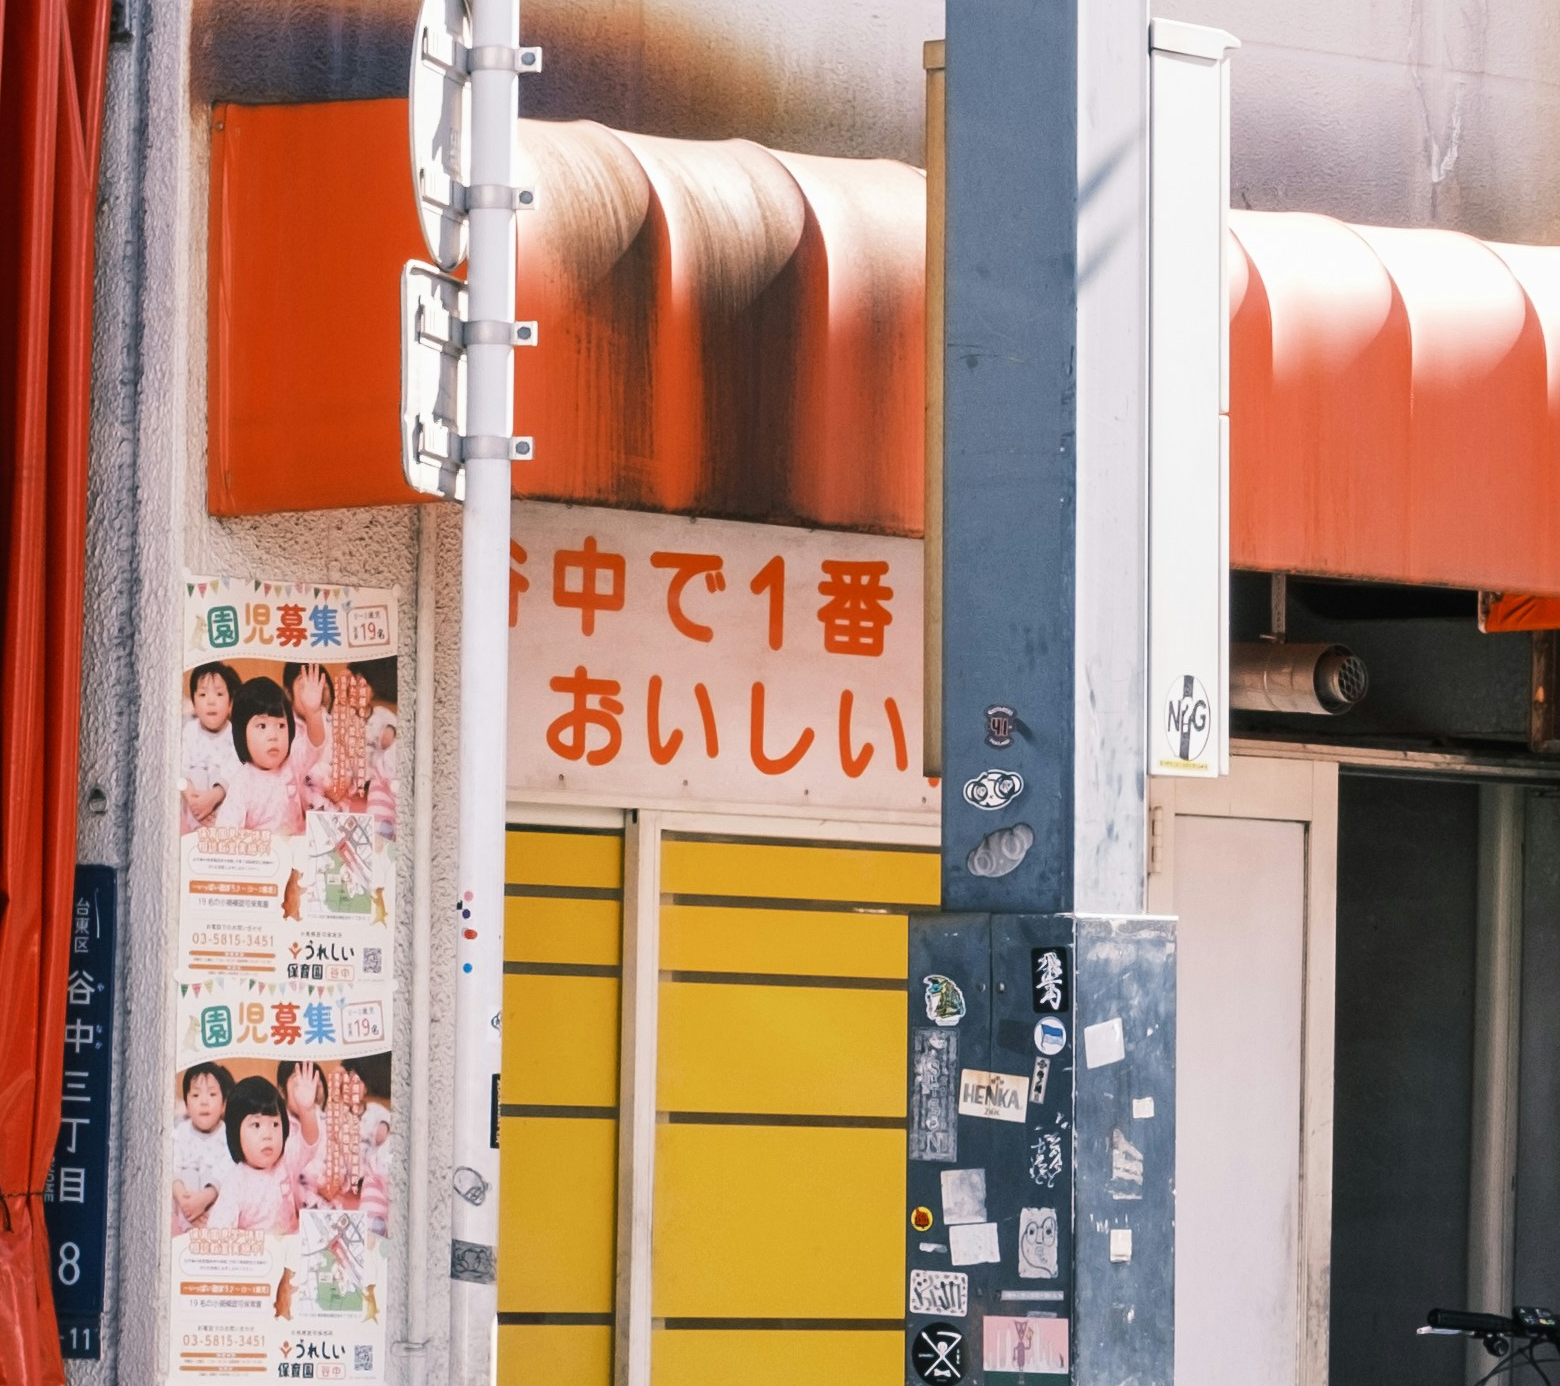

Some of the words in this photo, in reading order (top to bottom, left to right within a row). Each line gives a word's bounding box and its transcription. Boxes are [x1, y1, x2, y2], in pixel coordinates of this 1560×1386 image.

[207, 601, 343, 649] 園児募集
[546, 665, 909, 779] おいしい
[74, 897, 90, 954] 台東区
[191, 932, 275, 948] 03-5815-3451
[304, 940, 355, 962] うれしい
[287, 963, 323, 981] 保育園
[200, 1001, 337, 1049] 園児募集
[58, 969, 96, 1204] 谷中三丁目
[962, 1083, 1021, 1111] HENKA
[58, 1241, 81, 1286] 8
[182, 1334, 266, 1348] 03-5815-3451
[295, 1339, 346, 1360] うれしい
[277, 1363, 314, 1379] 保育園
